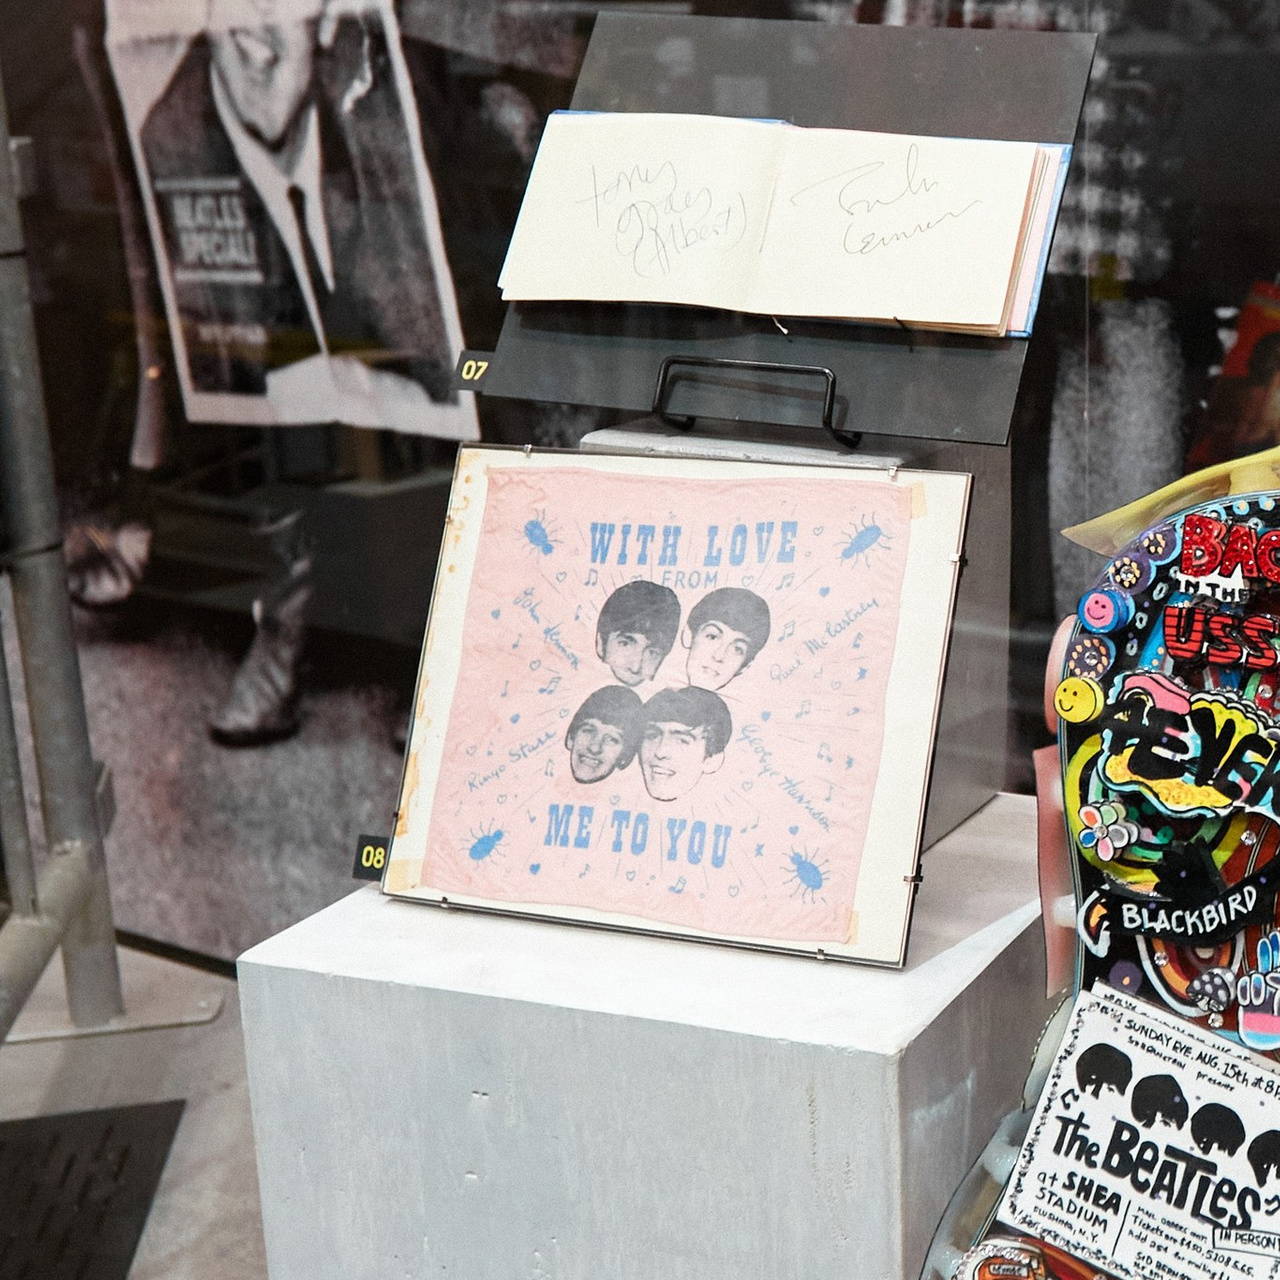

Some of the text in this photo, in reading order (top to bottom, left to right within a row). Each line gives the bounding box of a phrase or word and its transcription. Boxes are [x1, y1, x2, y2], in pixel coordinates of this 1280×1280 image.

[461, 359, 489, 381] 07
[590, 520, 799, 567] WITH LOVE
[661, 569, 719, 590] FROM
[1206, 581, 1251, 605] THE
[543, 803, 733, 869] ME TO YOU
[360, 844, 386, 870] 08
[1121, 883, 1258, 937] BLACKBIRD
[1124, 1019, 1173, 1047] SUNDAY
[1195, 1050, 1220, 1071] AUG.
[1221, 1062, 1249, 1087] 15th
[1264, 1080, 1275, 1094] 8
[1052, 1112, 1102, 1170] The
[1037, 1171, 1122, 1216] at SHEA
[1035, 1186, 1108, 1234] STADIUM
[1128, 1229, 1148, 1244] Add
[1132, 1214, 1164, 1237] Tickets
[1217, 1224, 1234, 1243] IN
[1136, 1251, 1153, 1266] SID
